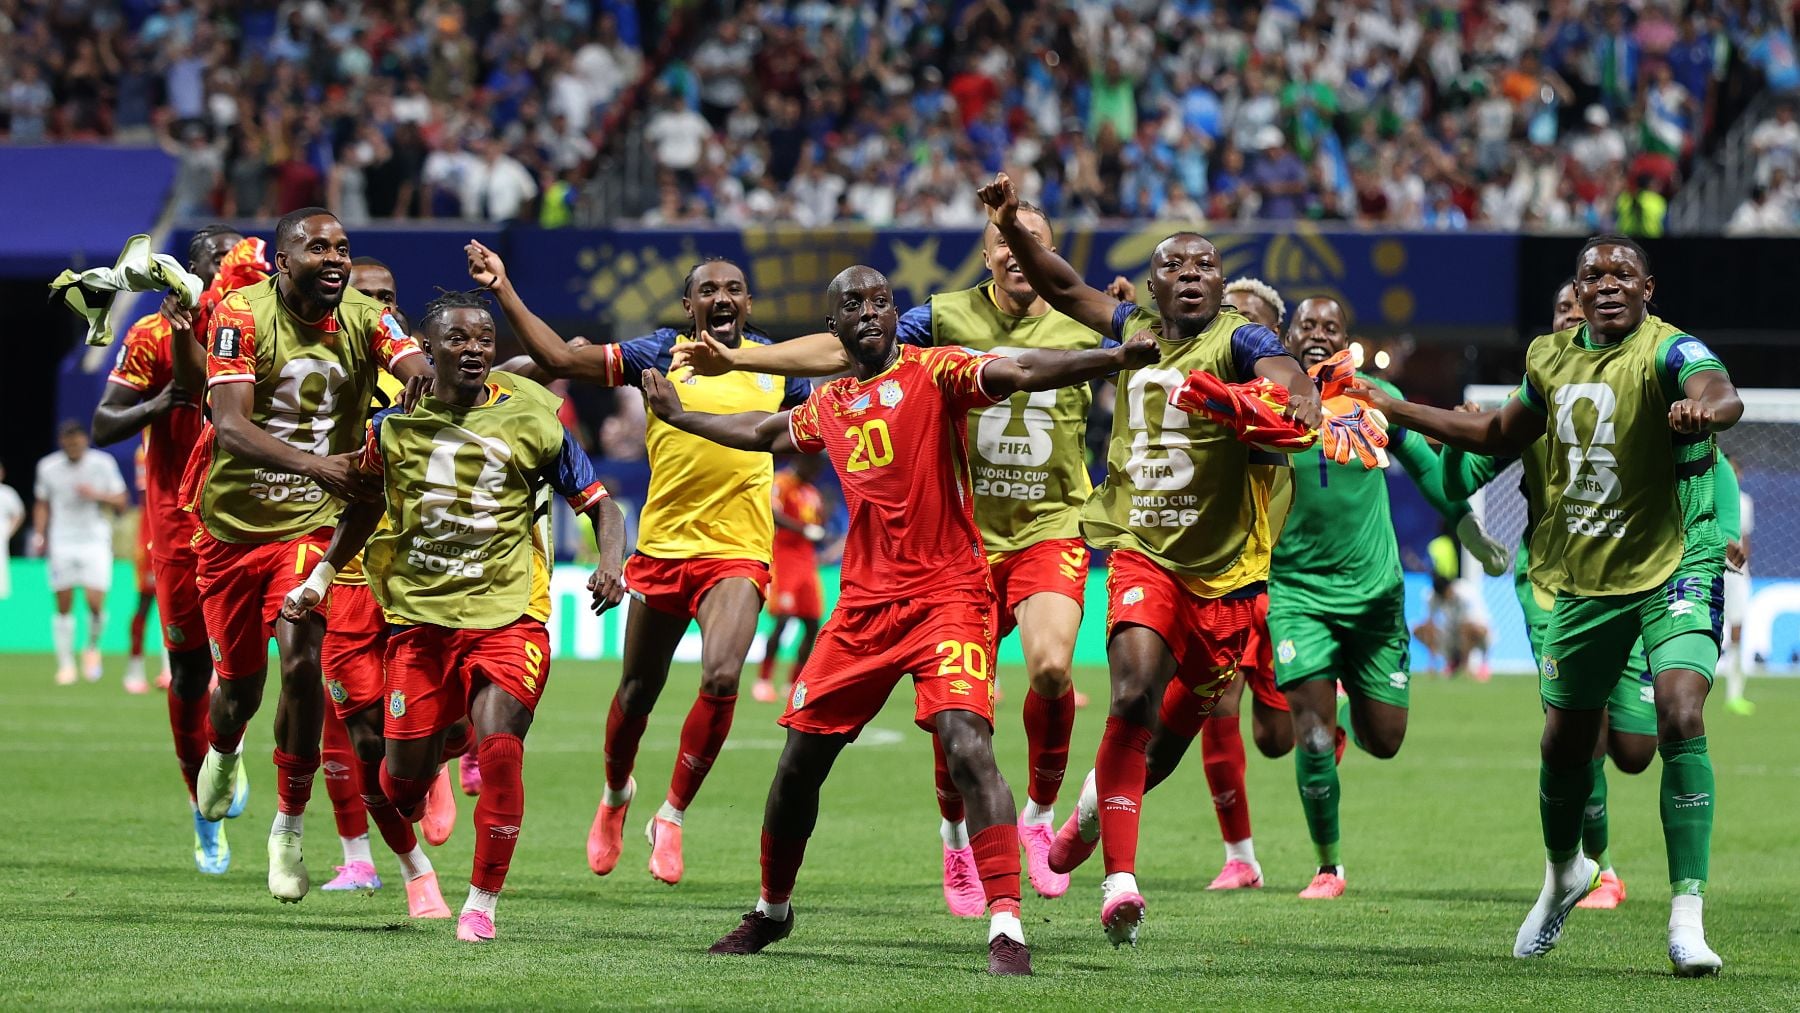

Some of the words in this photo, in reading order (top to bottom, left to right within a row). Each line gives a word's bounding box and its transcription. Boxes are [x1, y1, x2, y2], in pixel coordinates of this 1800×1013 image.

[844, 418, 894, 473] 20
[998, 442, 1032, 455] FIFA
[254, 466, 302, 485] WORLD
[976, 466, 1022, 480] WORLD
[1024, 471, 1049, 482] CUP
[1141, 465, 1174, 479] FIFA
[249, 482, 323, 502] 2026
[975, 478, 1046, 500] 2026
[1574, 479, 1605, 494] FIFA
[1169, 494, 1198, 506] CUP
[440, 518, 475, 535] FIFA
[1128, 508, 1199, 528] 2026
[1566, 516, 1626, 539] 2026
[412, 536, 460, 556] WORLD
[462, 548, 488, 561] CUP
[407, 549, 484, 579] 2026
[524, 640, 543, 679] 9
[935, 639, 987, 681] 20
